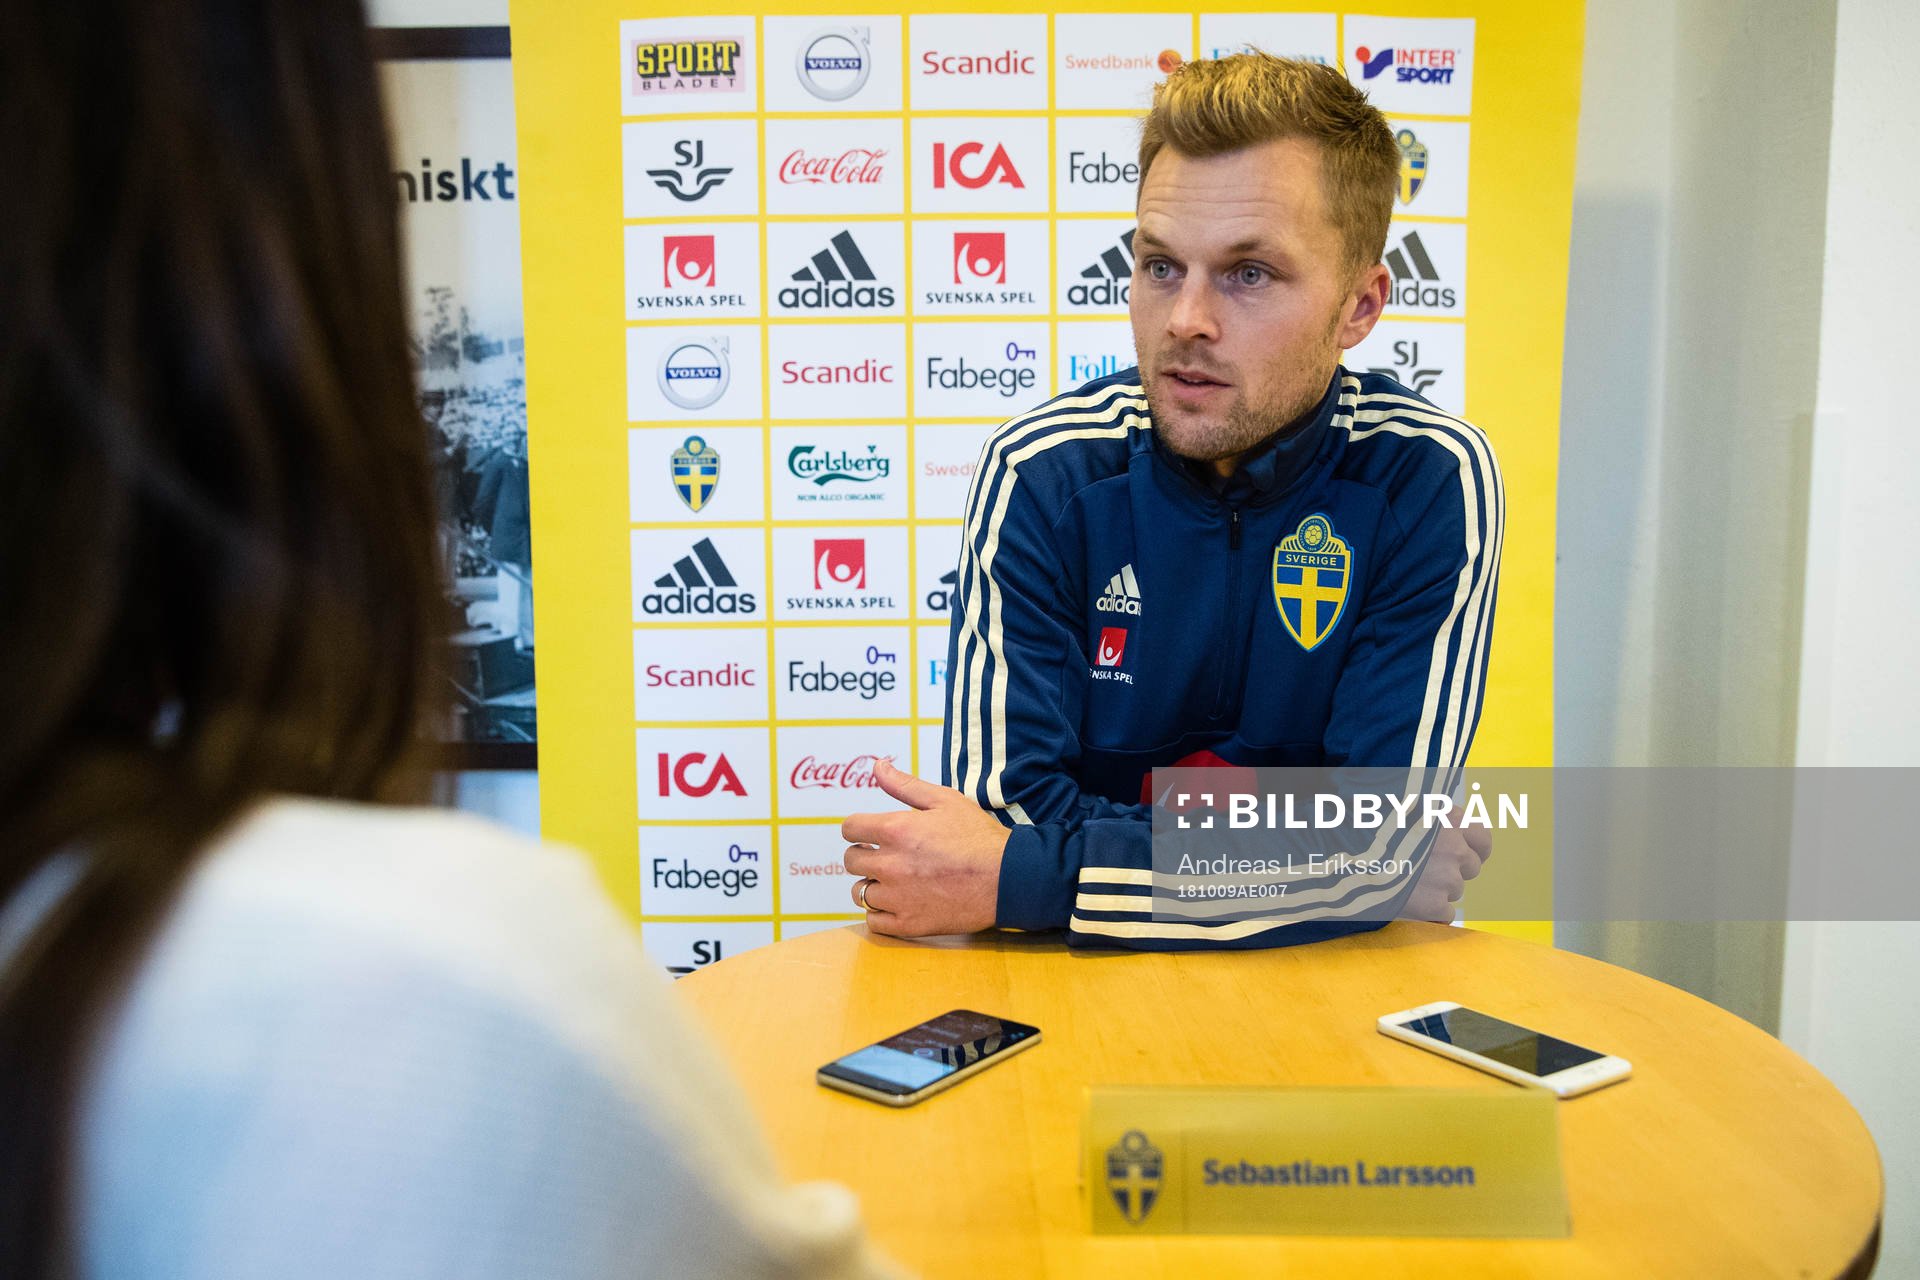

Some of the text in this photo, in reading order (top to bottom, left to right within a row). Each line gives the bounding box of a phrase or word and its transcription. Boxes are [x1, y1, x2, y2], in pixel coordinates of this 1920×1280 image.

[636, 39, 741, 78] SPORT
[808, 58, 860, 70] VOLVO
[923, 50, 1035, 75] Scandic
[1065, 54, 1153, 70] Swedbank
[1396, 48, 1455, 67] INTER
[642, 78, 736, 91] BLADET
[1396, 67, 1455, 84] SPORT
[674, 139, 704, 169] SJ
[778, 148, 890, 185] Coca-Cola
[932, 141, 1026, 190] ICA
[638, 295, 746, 309] SVENSKA SPEL
[778, 279, 895, 309] adidas
[926, 291, 1035, 304] SVENSKA SPEL
[1394, 341, 1418, 368] SJ
[668, 367, 720, 379] VOLVO
[782, 359, 893, 385] Scandic
[927, 358, 1036, 397] Fabege
[787, 445, 890, 480] Carlsberg
[1285, 554, 1337, 566] SVERIGE
[642, 587, 757, 614] adidas
[787, 597, 895, 609] SVENSKA SPEL
[646, 663, 755, 687] Scandic
[789, 661, 896, 700] Fabege
[1113, 670, 1134, 684] SPEL
[658, 751, 749, 798] ICA
[653, 857, 759, 897] Fabege
[1203, 1159, 1476, 1187] Sebastian Larsson
